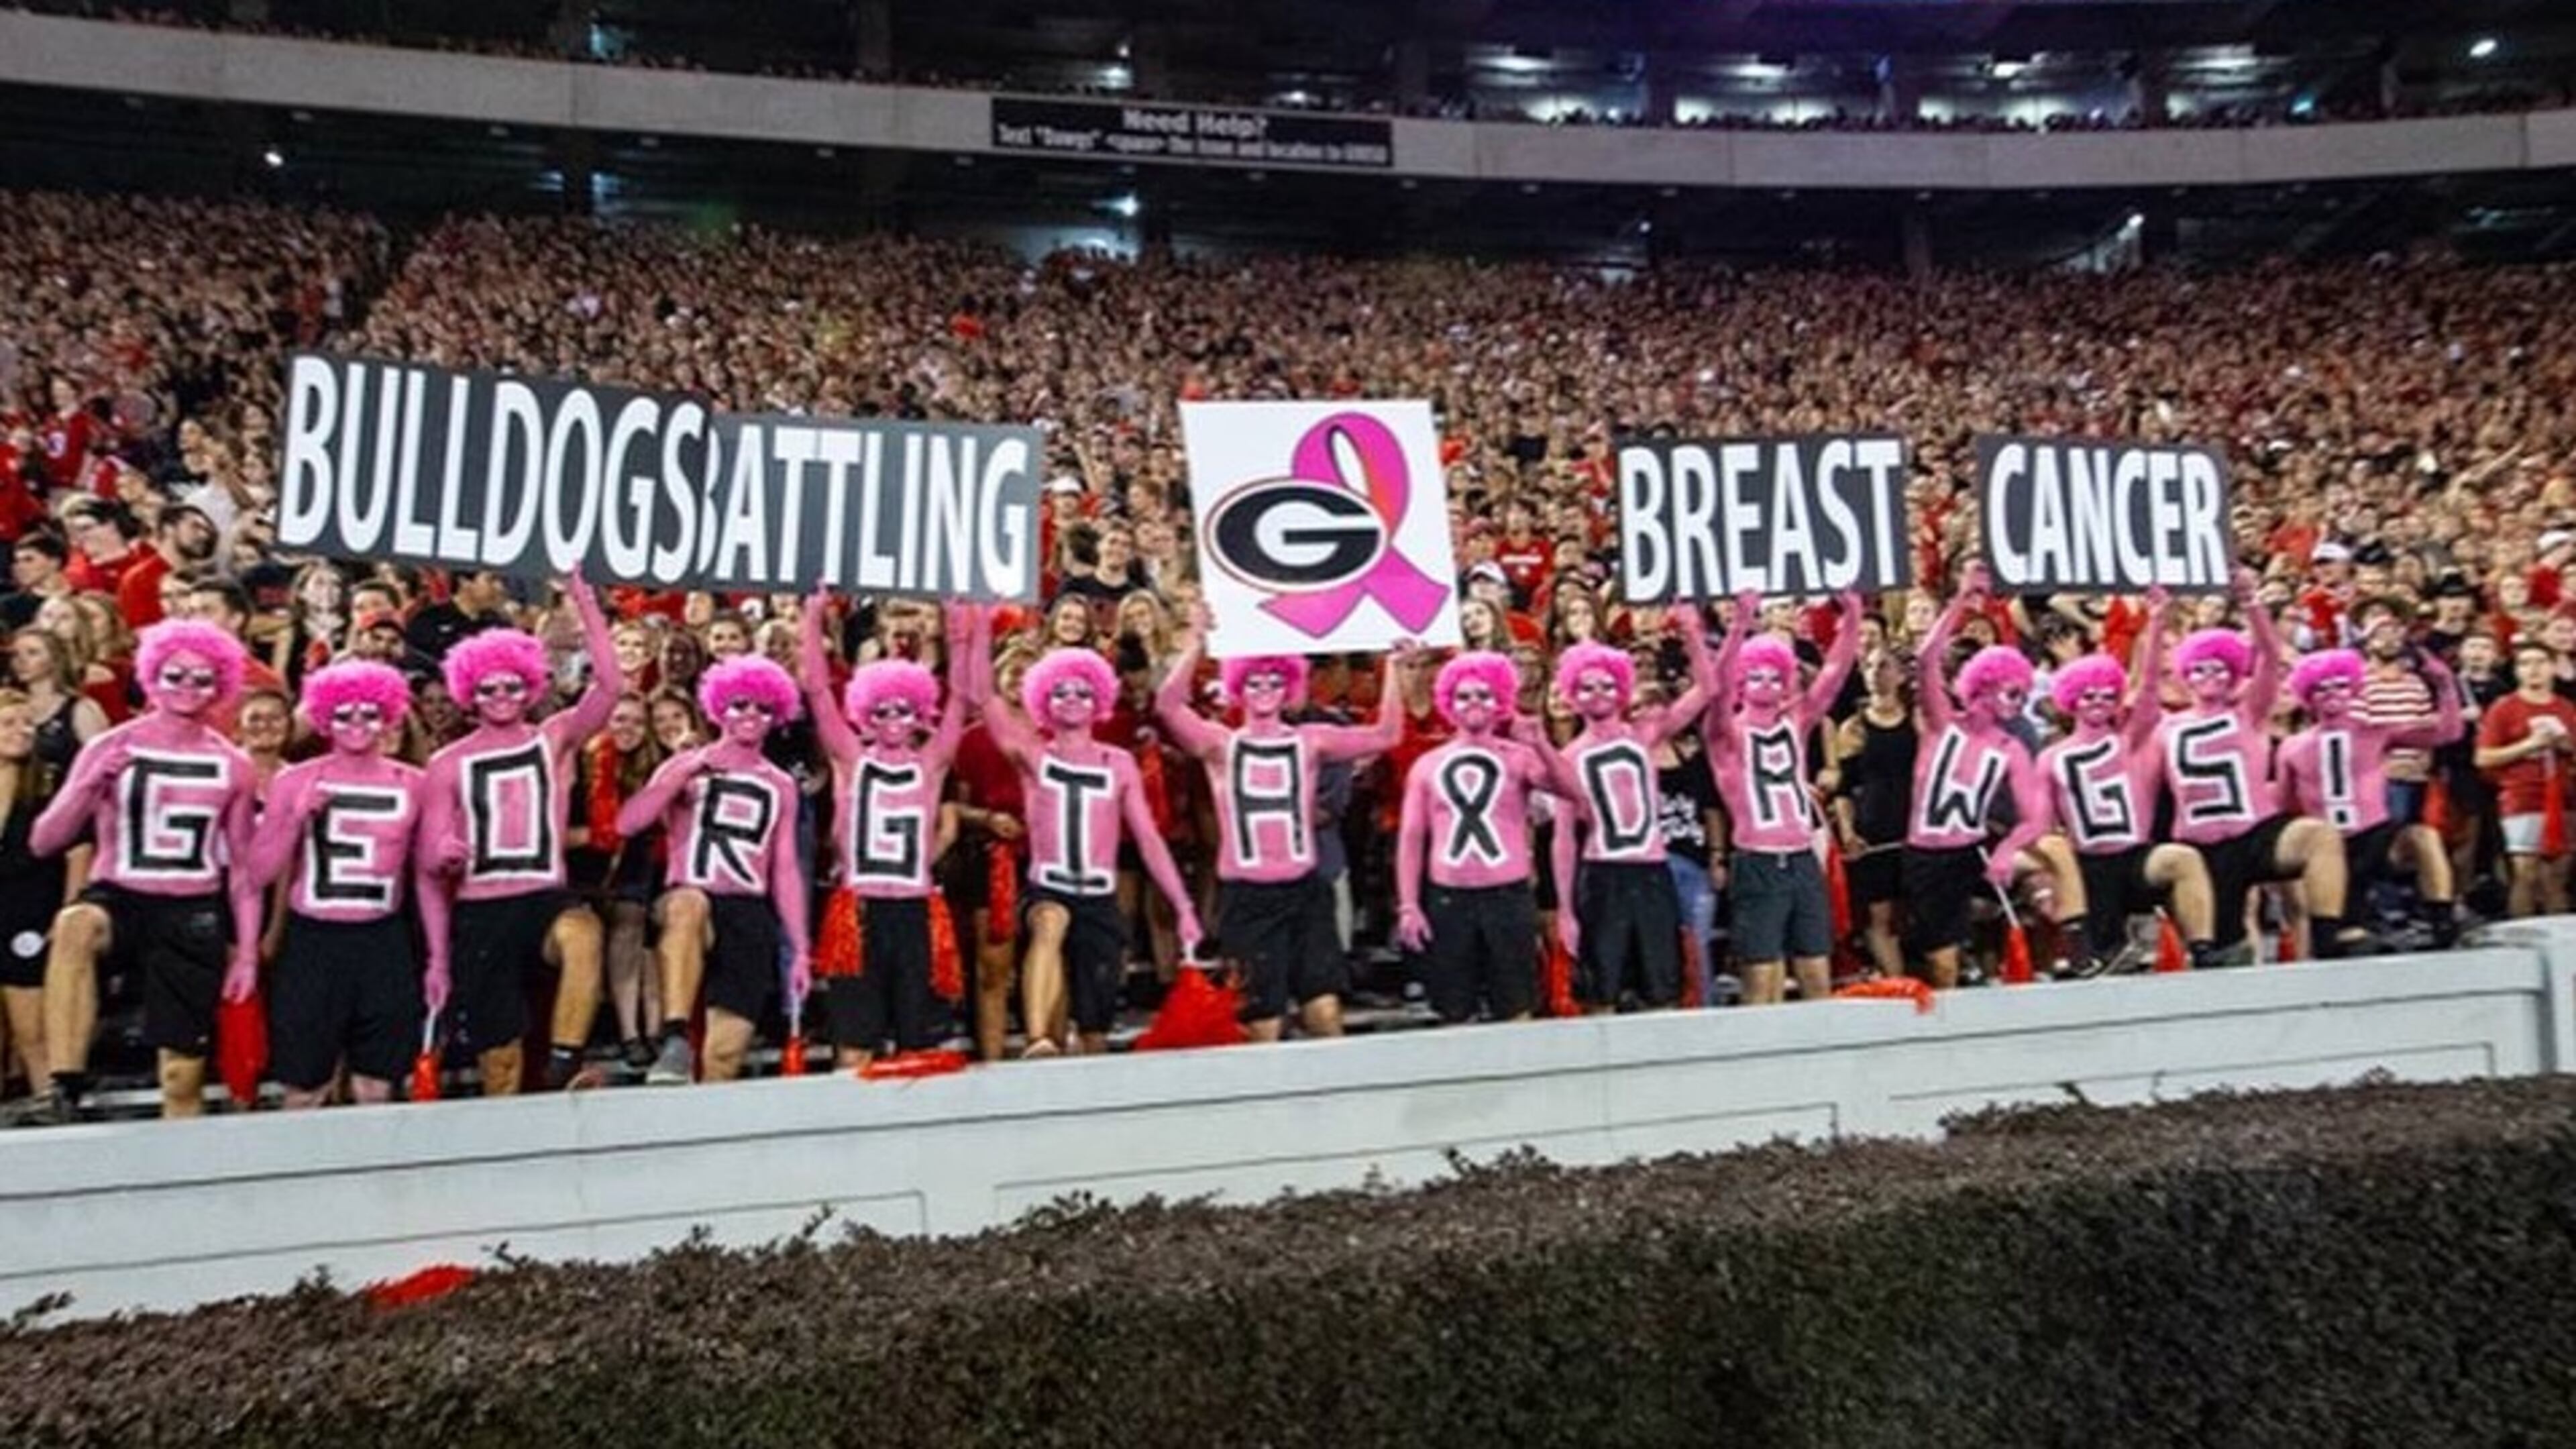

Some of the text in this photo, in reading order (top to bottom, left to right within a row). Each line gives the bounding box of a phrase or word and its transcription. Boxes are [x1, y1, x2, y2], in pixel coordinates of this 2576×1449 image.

[1124, 109, 1267, 137] Need Help?
[280, 355, 704, 583] BULLDOGS
[1214, 484, 1381, 585] G
[1617, 439, 1902, 602] BREAST
[1988, 443, 2229, 586] CANCER
